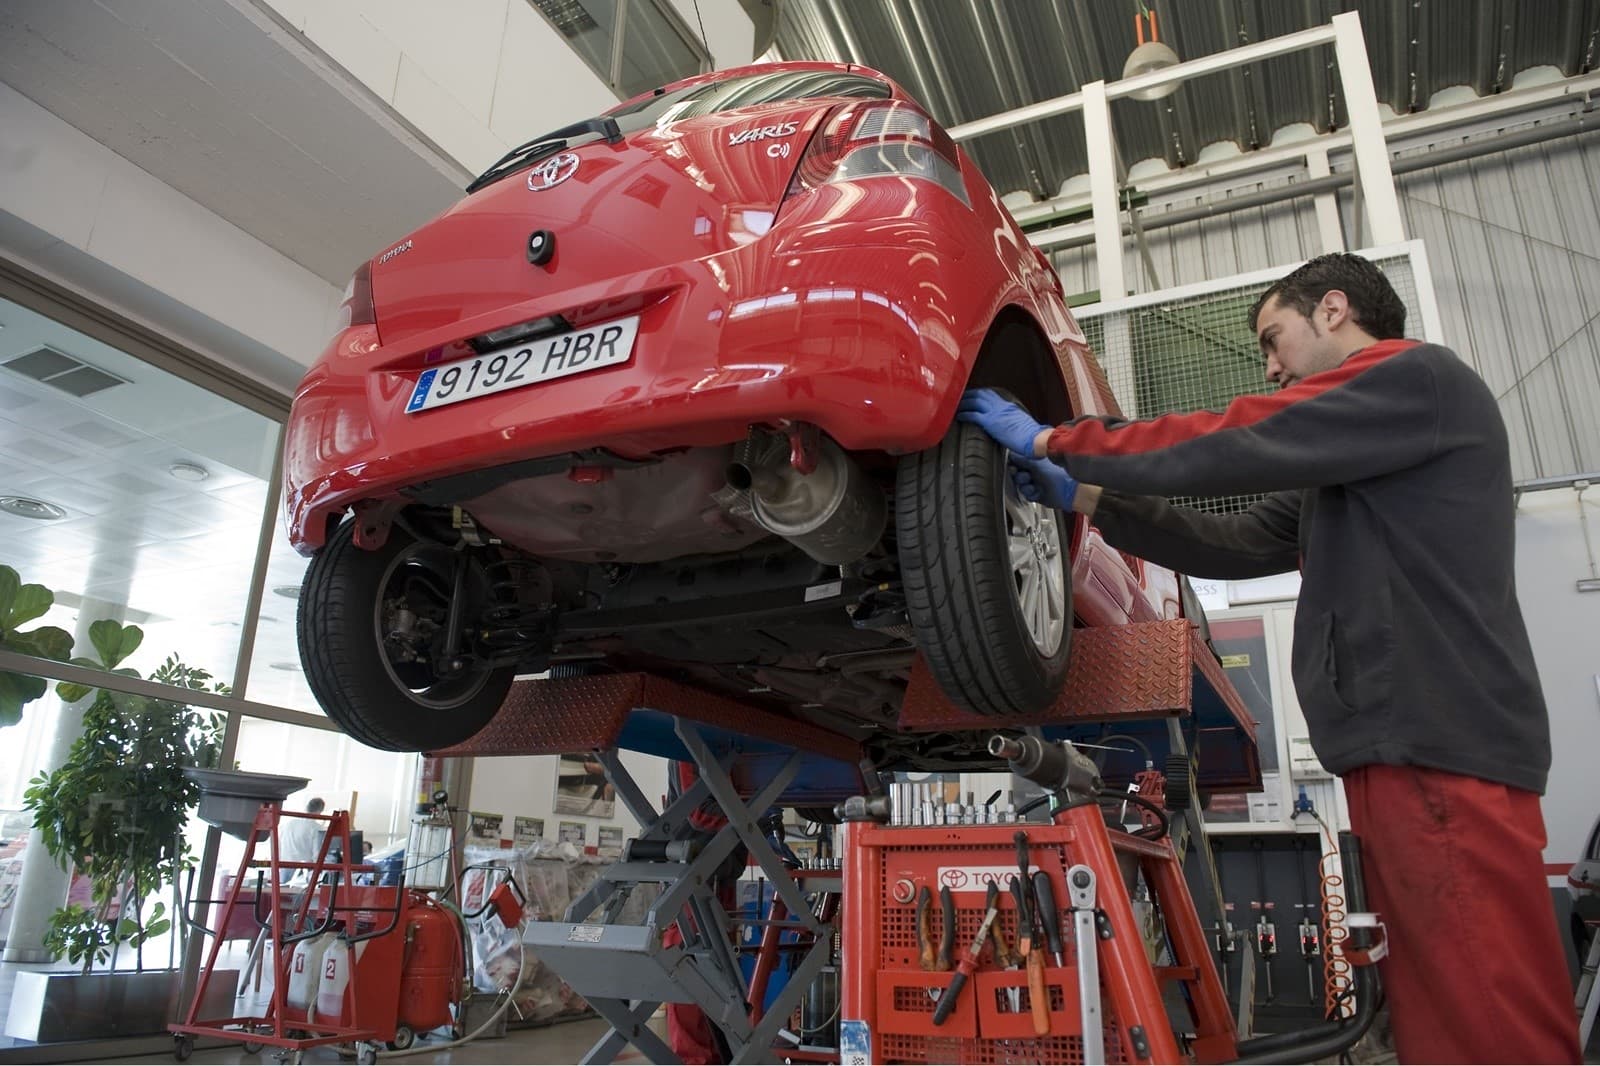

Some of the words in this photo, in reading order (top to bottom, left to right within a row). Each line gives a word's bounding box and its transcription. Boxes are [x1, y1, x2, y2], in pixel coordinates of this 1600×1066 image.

[728, 121, 800, 146] YARIS
[436, 348, 533, 399] 9192
[541, 325, 623, 374] HBR
[414, 394, 424, 405] E
[972, 872, 1034, 886] TOYO
[326, 961, 335, 977] 2
